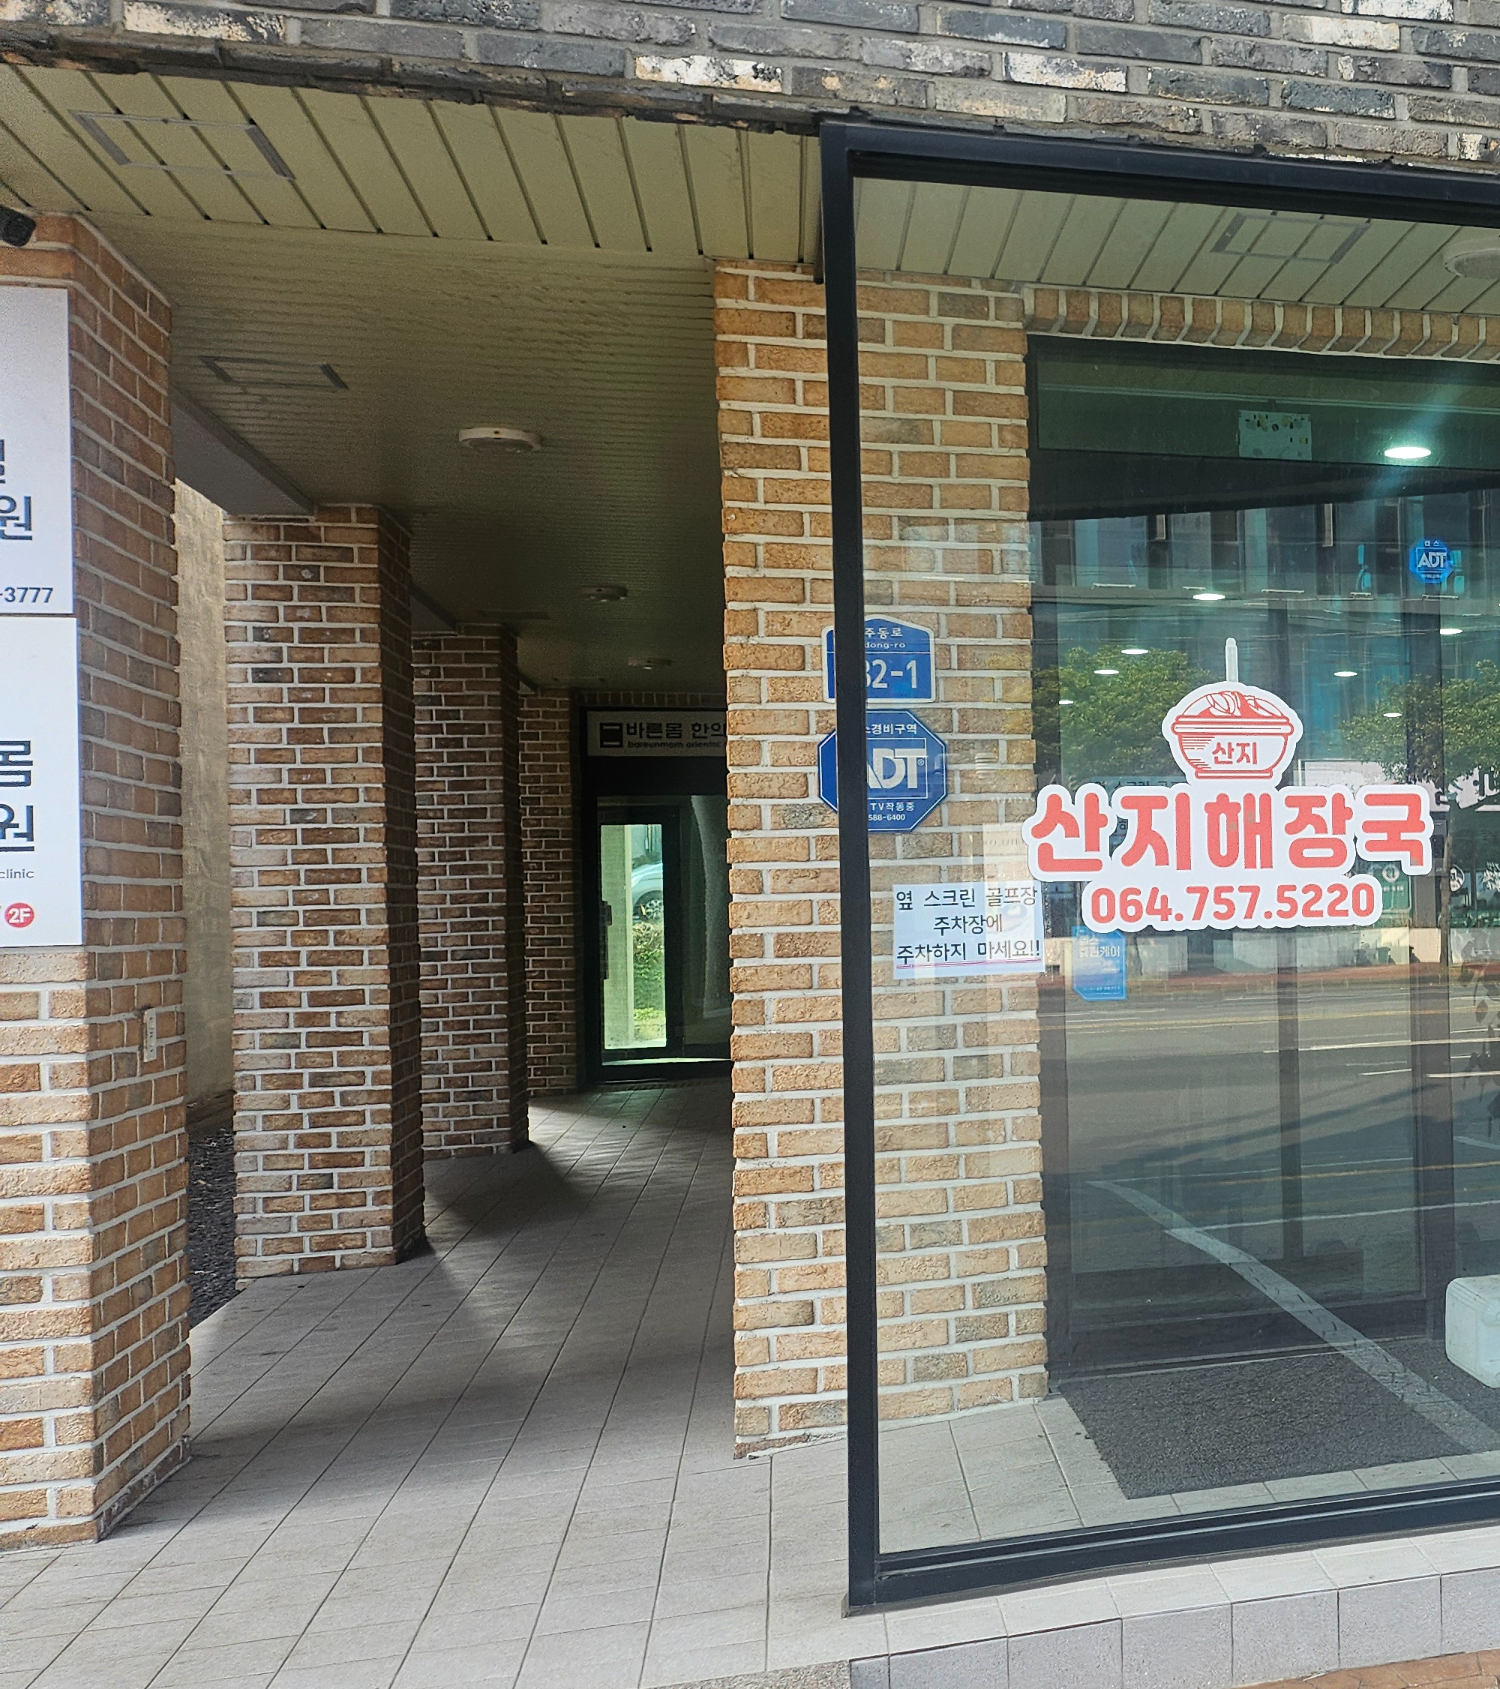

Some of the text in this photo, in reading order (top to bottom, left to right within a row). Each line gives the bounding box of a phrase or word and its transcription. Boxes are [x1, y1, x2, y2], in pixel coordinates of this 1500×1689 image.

[1417, 551, 1447, 568] ADT
[626, 722, 684, 739] 바른몸
[1211, 741, 1258, 765] 산지
[1031, 792, 1425, 873] 산지해장국
[896, 886, 1037, 911] 옆 스크린 골프장
[1091, 882, 1375, 924] 064.757.5220
[8, 908, 31, 924] 2F
[934, 913, 1002, 936] 주차장에
[897, 939, 1040, 965] 주차하지 마세요!!
